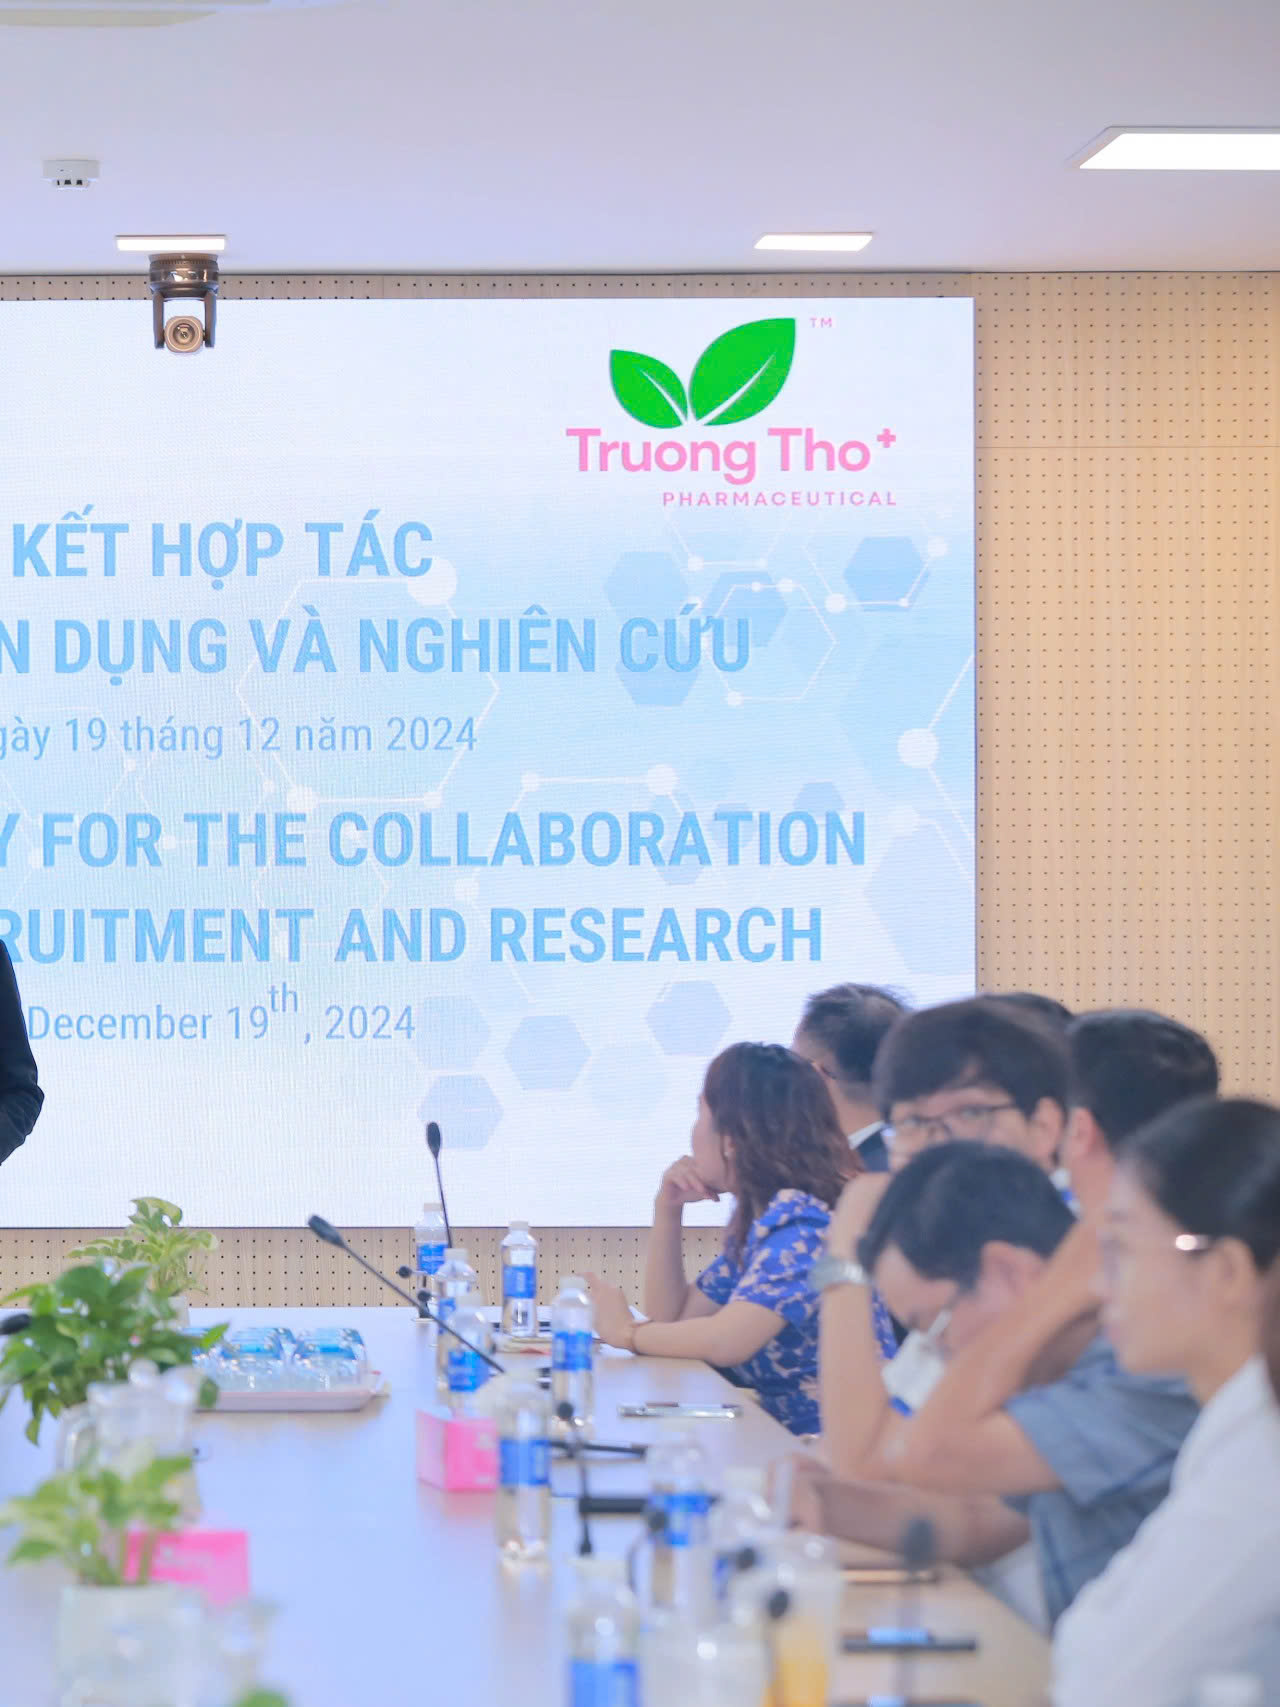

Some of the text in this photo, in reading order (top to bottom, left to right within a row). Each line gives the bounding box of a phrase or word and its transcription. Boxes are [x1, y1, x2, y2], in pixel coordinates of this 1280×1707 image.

[565, 428, 756, 486] Truong
[662, 491, 897, 507] PHARMACEUTICAL
[12, 503, 130, 578] KẾT
[151, 518, 284, 591] HỢP
[304, 508, 433, 577] TÁC
[54, 618, 227, 687] DỤNG
[248, 604, 338, 673] VÀ
[359, 604, 596, 673] NGHIÊN
[619, 603, 750, 674] CỨU
[65, 717, 107, 752] 19
[119, 715, 223, 761] tháng
[238, 716, 281, 752] 12
[295, 716, 372, 752] năm
[387, 716, 478, 751] 2024
[42, 812, 162, 868] FOR
[183, 812, 307, 867] THE
[329, 810, 865, 867] COLLABORATION
[334, 908, 467, 962] AND
[490, 907, 822, 964] RESEARCH
[29, 1004, 213, 1040] December
[325, 1004, 416, 1040] 2024
